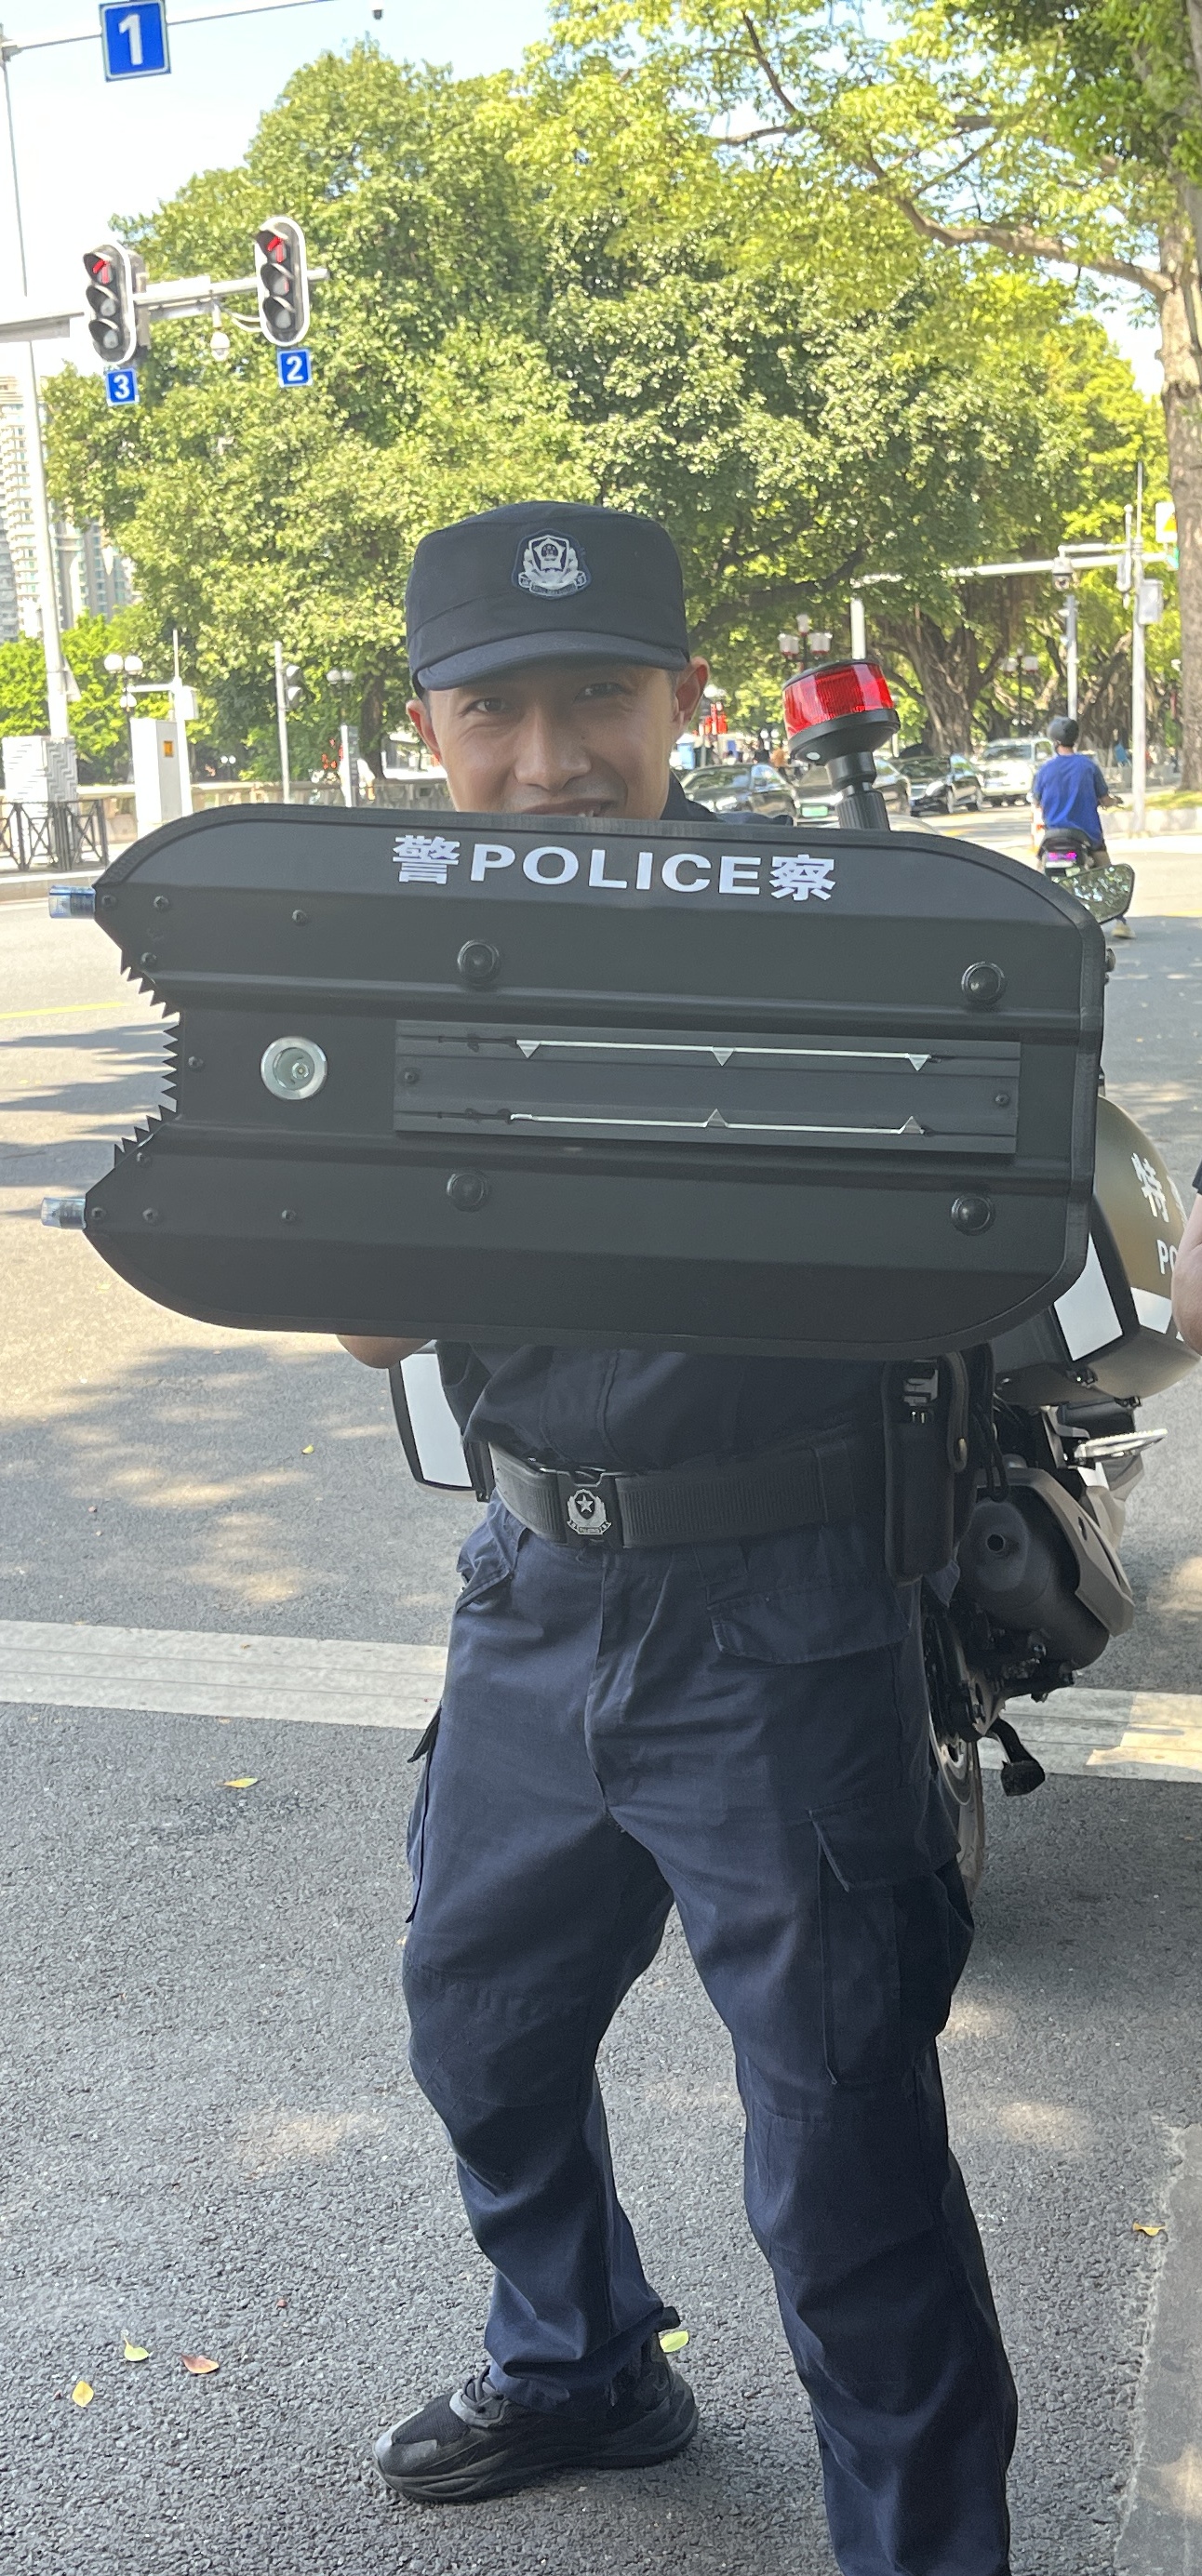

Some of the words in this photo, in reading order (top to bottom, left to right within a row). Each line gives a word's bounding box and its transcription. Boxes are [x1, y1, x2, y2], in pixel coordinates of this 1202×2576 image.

[118, 13, 143, 66] 1
[286, 355, 304, 381] 2
[113, 374, 131, 400] 3
